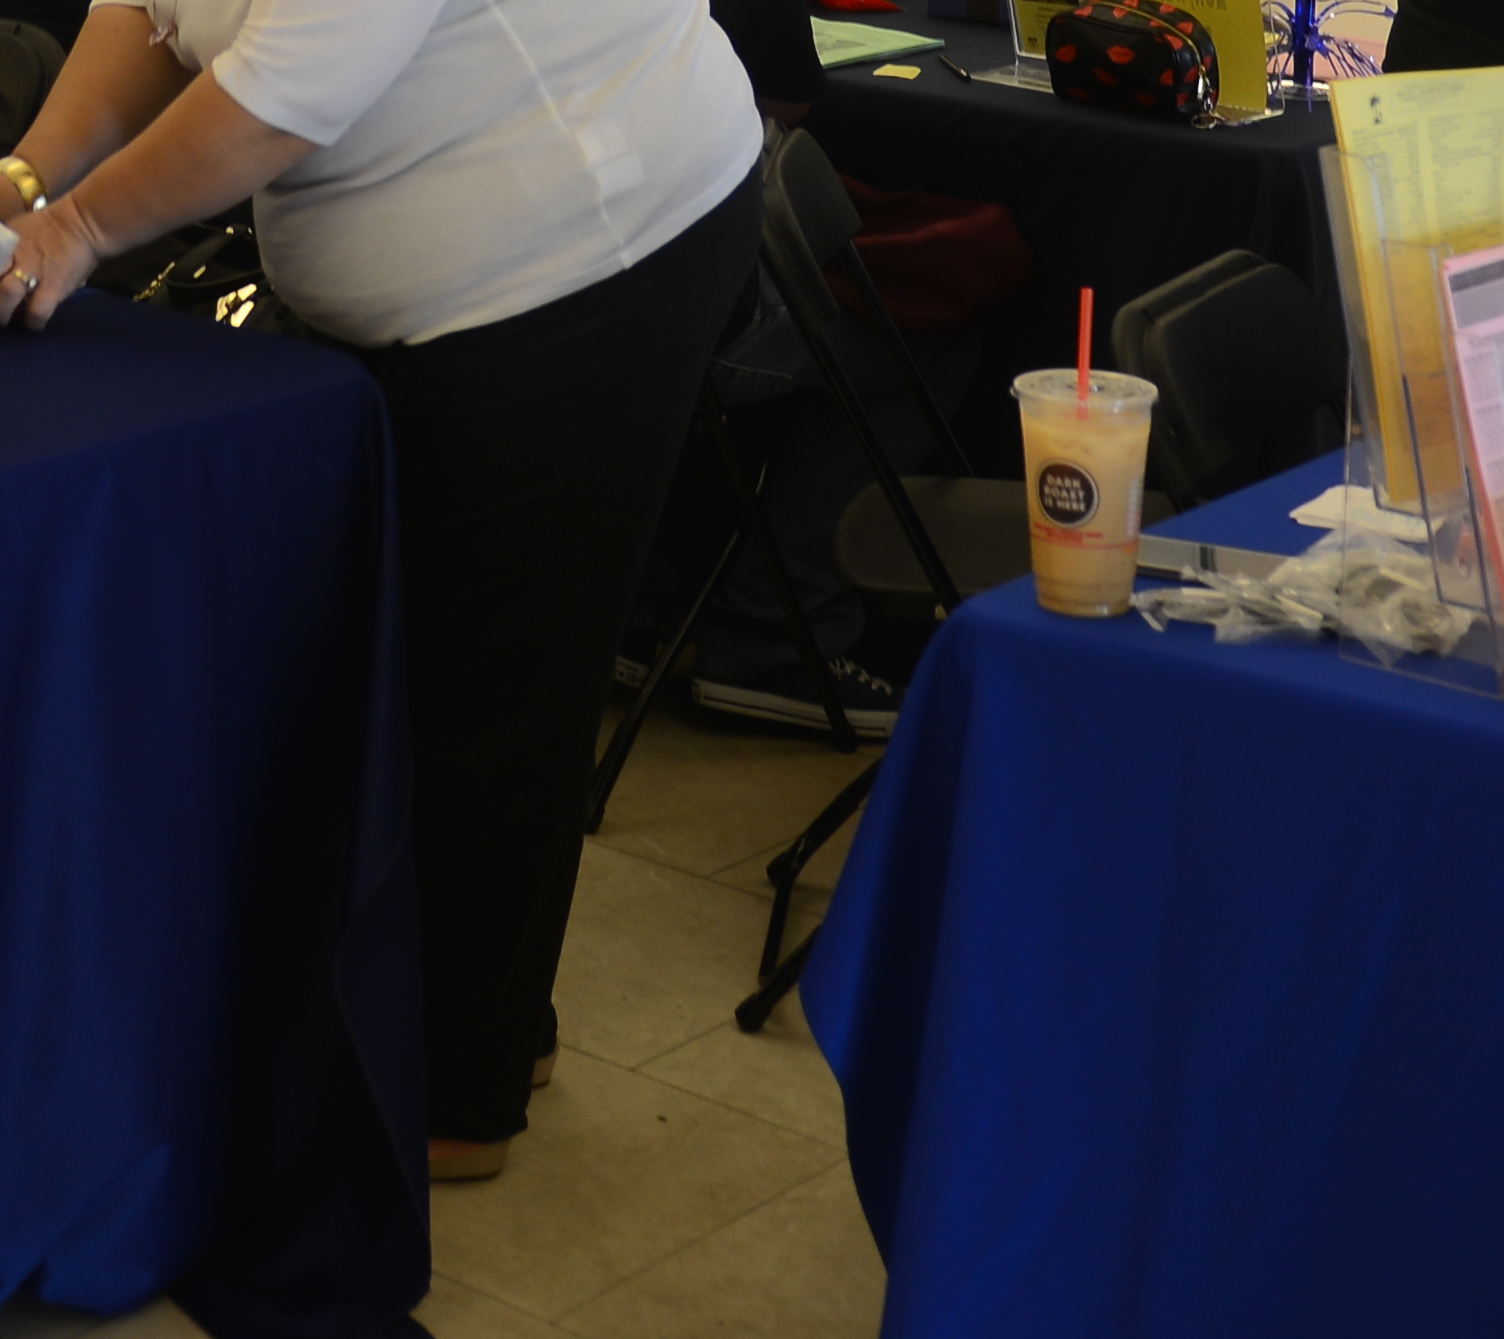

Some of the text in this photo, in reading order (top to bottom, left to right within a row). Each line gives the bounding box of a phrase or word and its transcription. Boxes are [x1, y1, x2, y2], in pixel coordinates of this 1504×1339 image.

[1047, 473, 1082, 488] DARK
[1043, 484, 1085, 500] ROAST
[1044, 496, 1087, 513] IS HERE
